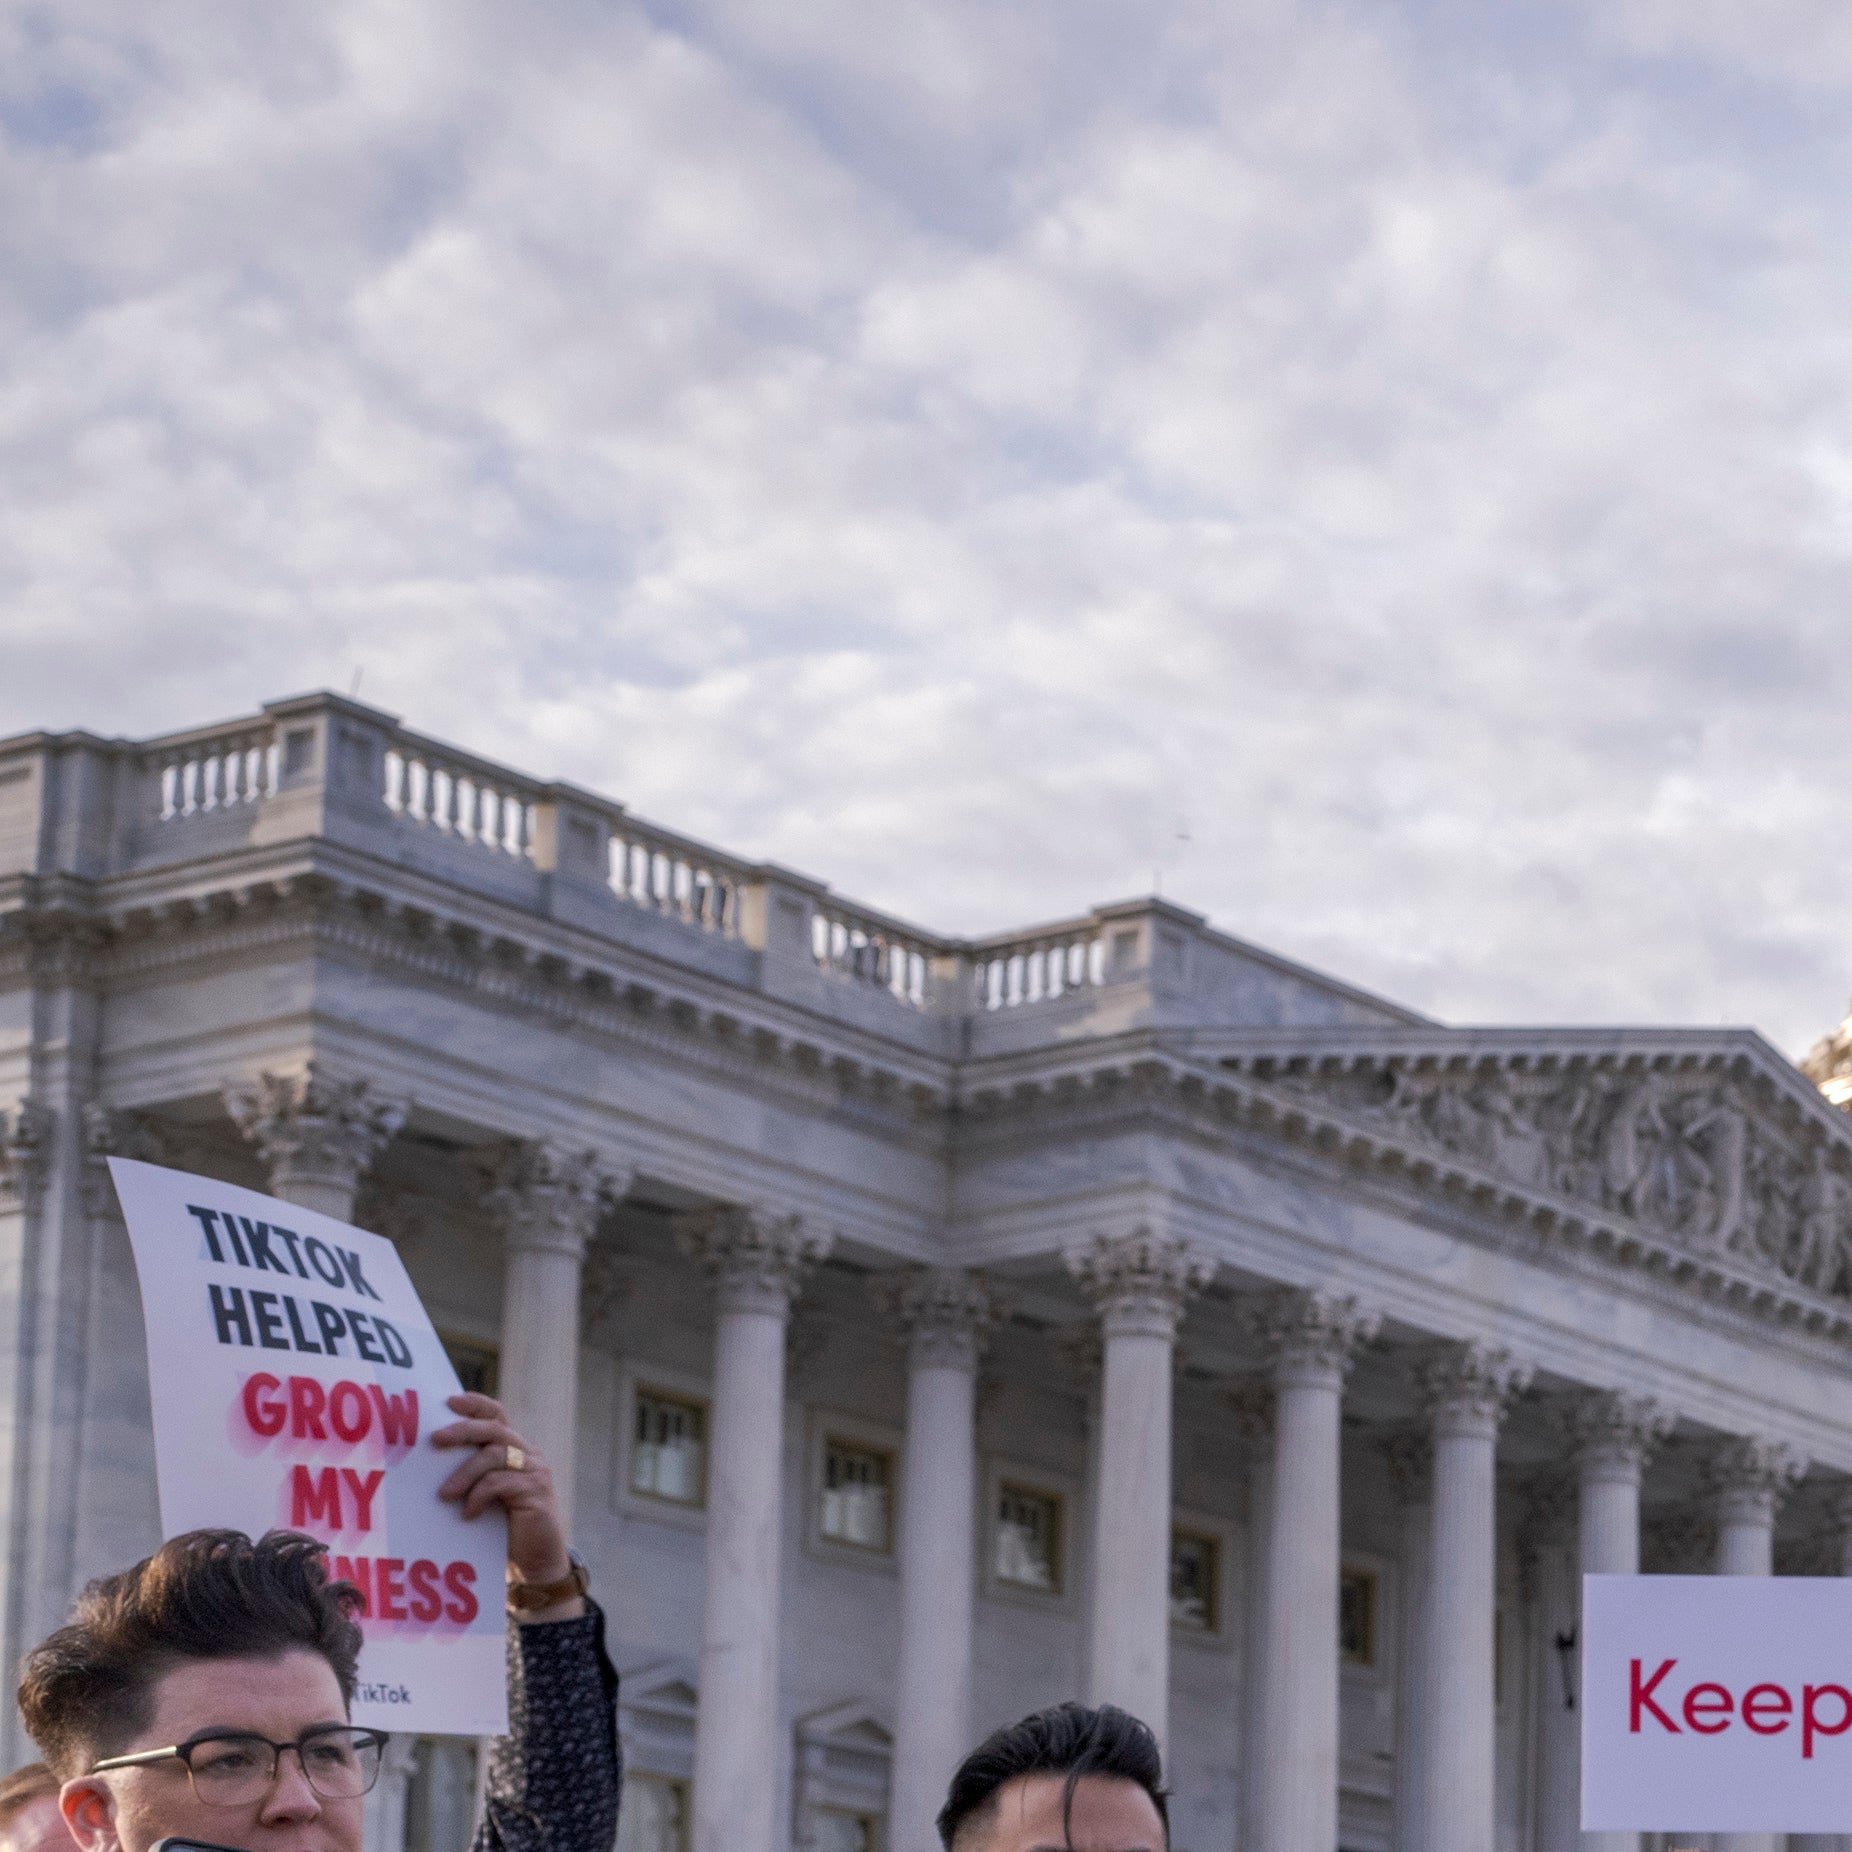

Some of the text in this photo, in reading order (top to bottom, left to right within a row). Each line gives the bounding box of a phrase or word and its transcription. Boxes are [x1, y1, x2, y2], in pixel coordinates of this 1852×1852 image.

[187, 1204, 381, 1301] TIKTOK
[208, 1284, 412, 1369] HELPED
[241, 1372, 419, 1447] GROW
[290, 1465, 385, 1532] MY
[319, 1554, 479, 1624] NESS
